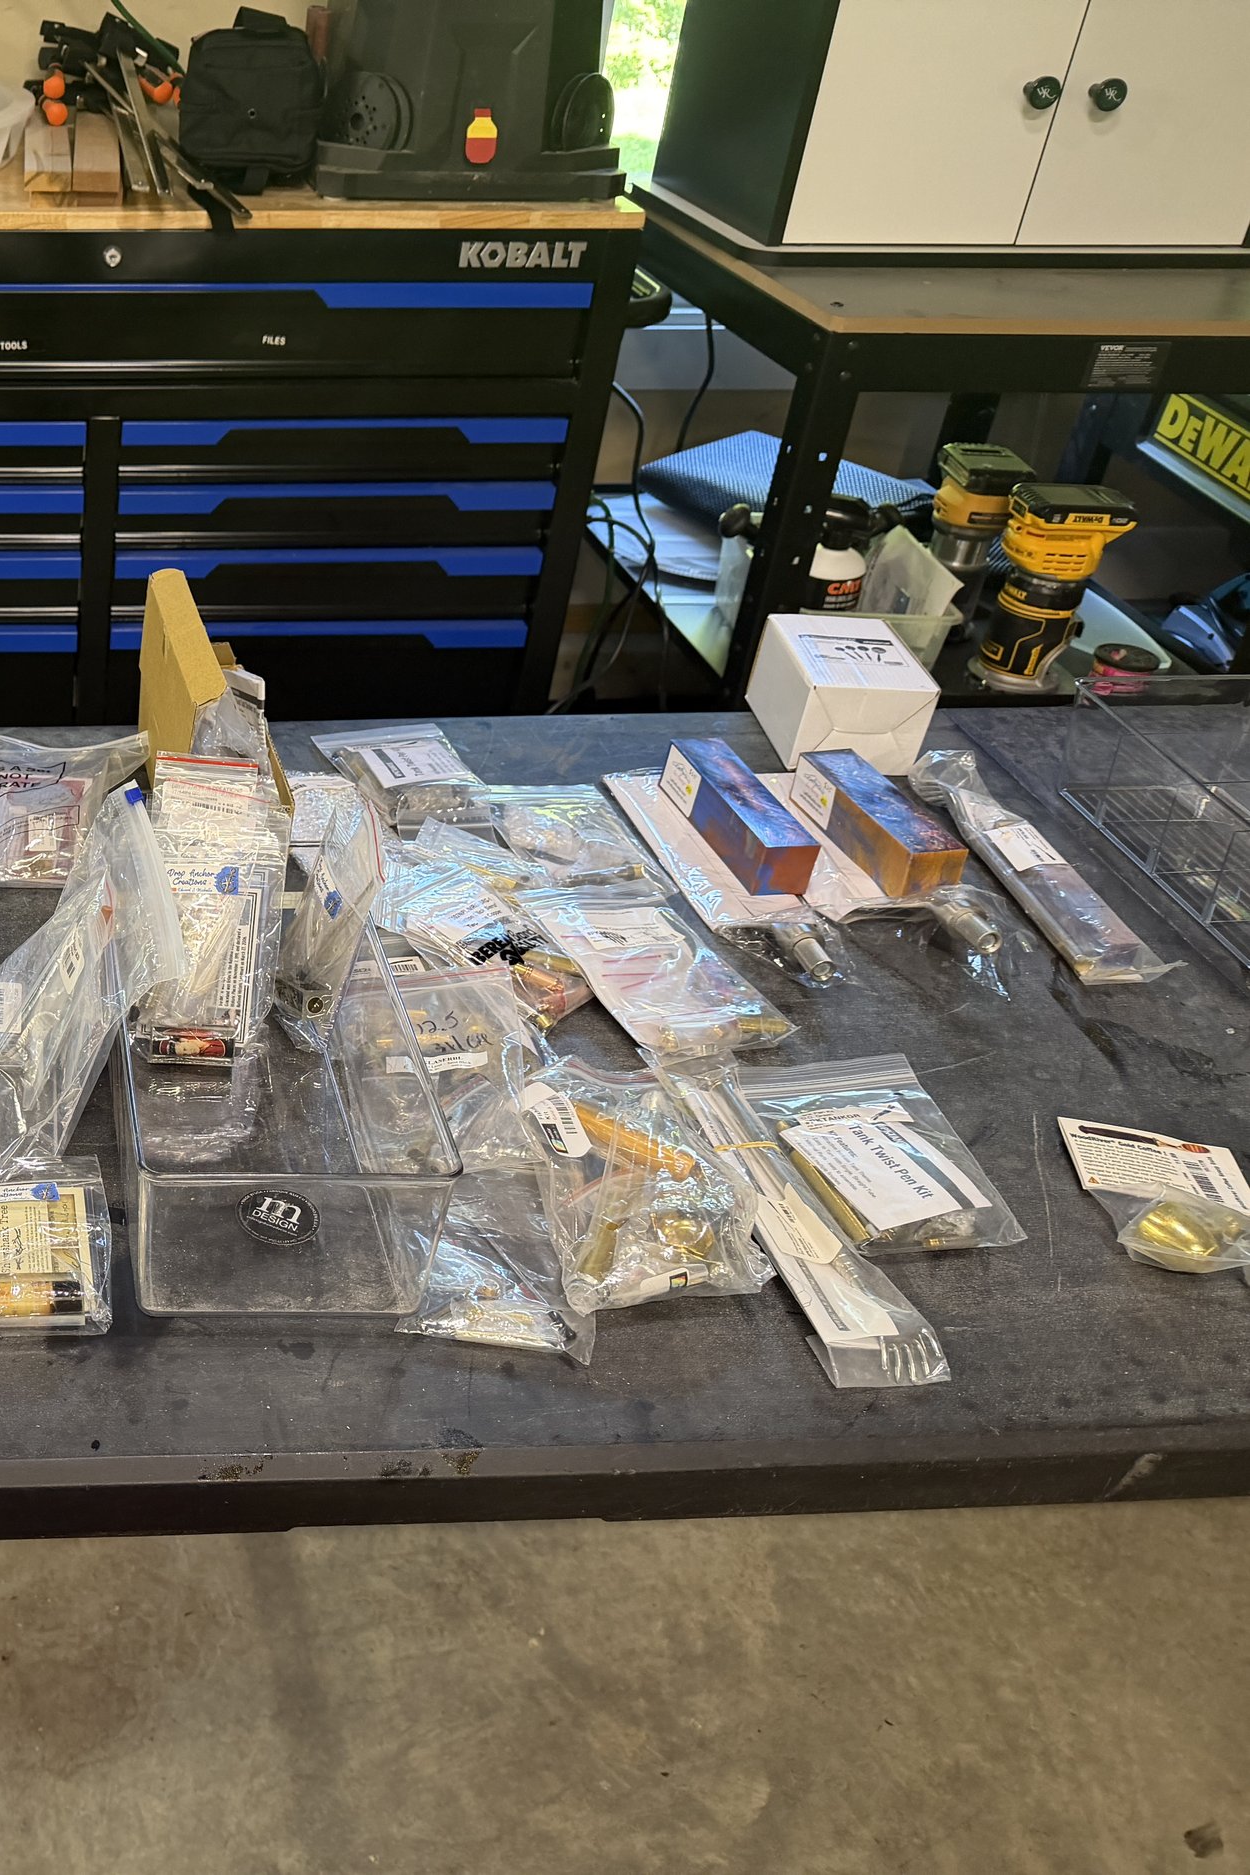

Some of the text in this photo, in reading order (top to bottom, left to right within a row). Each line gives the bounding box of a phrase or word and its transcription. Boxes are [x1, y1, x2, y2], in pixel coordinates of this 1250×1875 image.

[458, 241, 588, 269] KOBALT
[0, 340, 28, 350] TOOLS
[261, 334, 287, 346] FILES
[1155, 392, 1250, 492] DEWA
[166, 867, 215, 879] Drop Anchor
[172, 877, 208, 886] Creations
[848, 1124, 872, 1145] Tank
[870, 1145, 898, 1169] Twist
[894, 1168, 914, 1186] Pen
[913, 1184, 934, 1199] Kit
[0, 1204, 9, 1224] Tree
[251, 1209, 299, 1232] DESIGN
